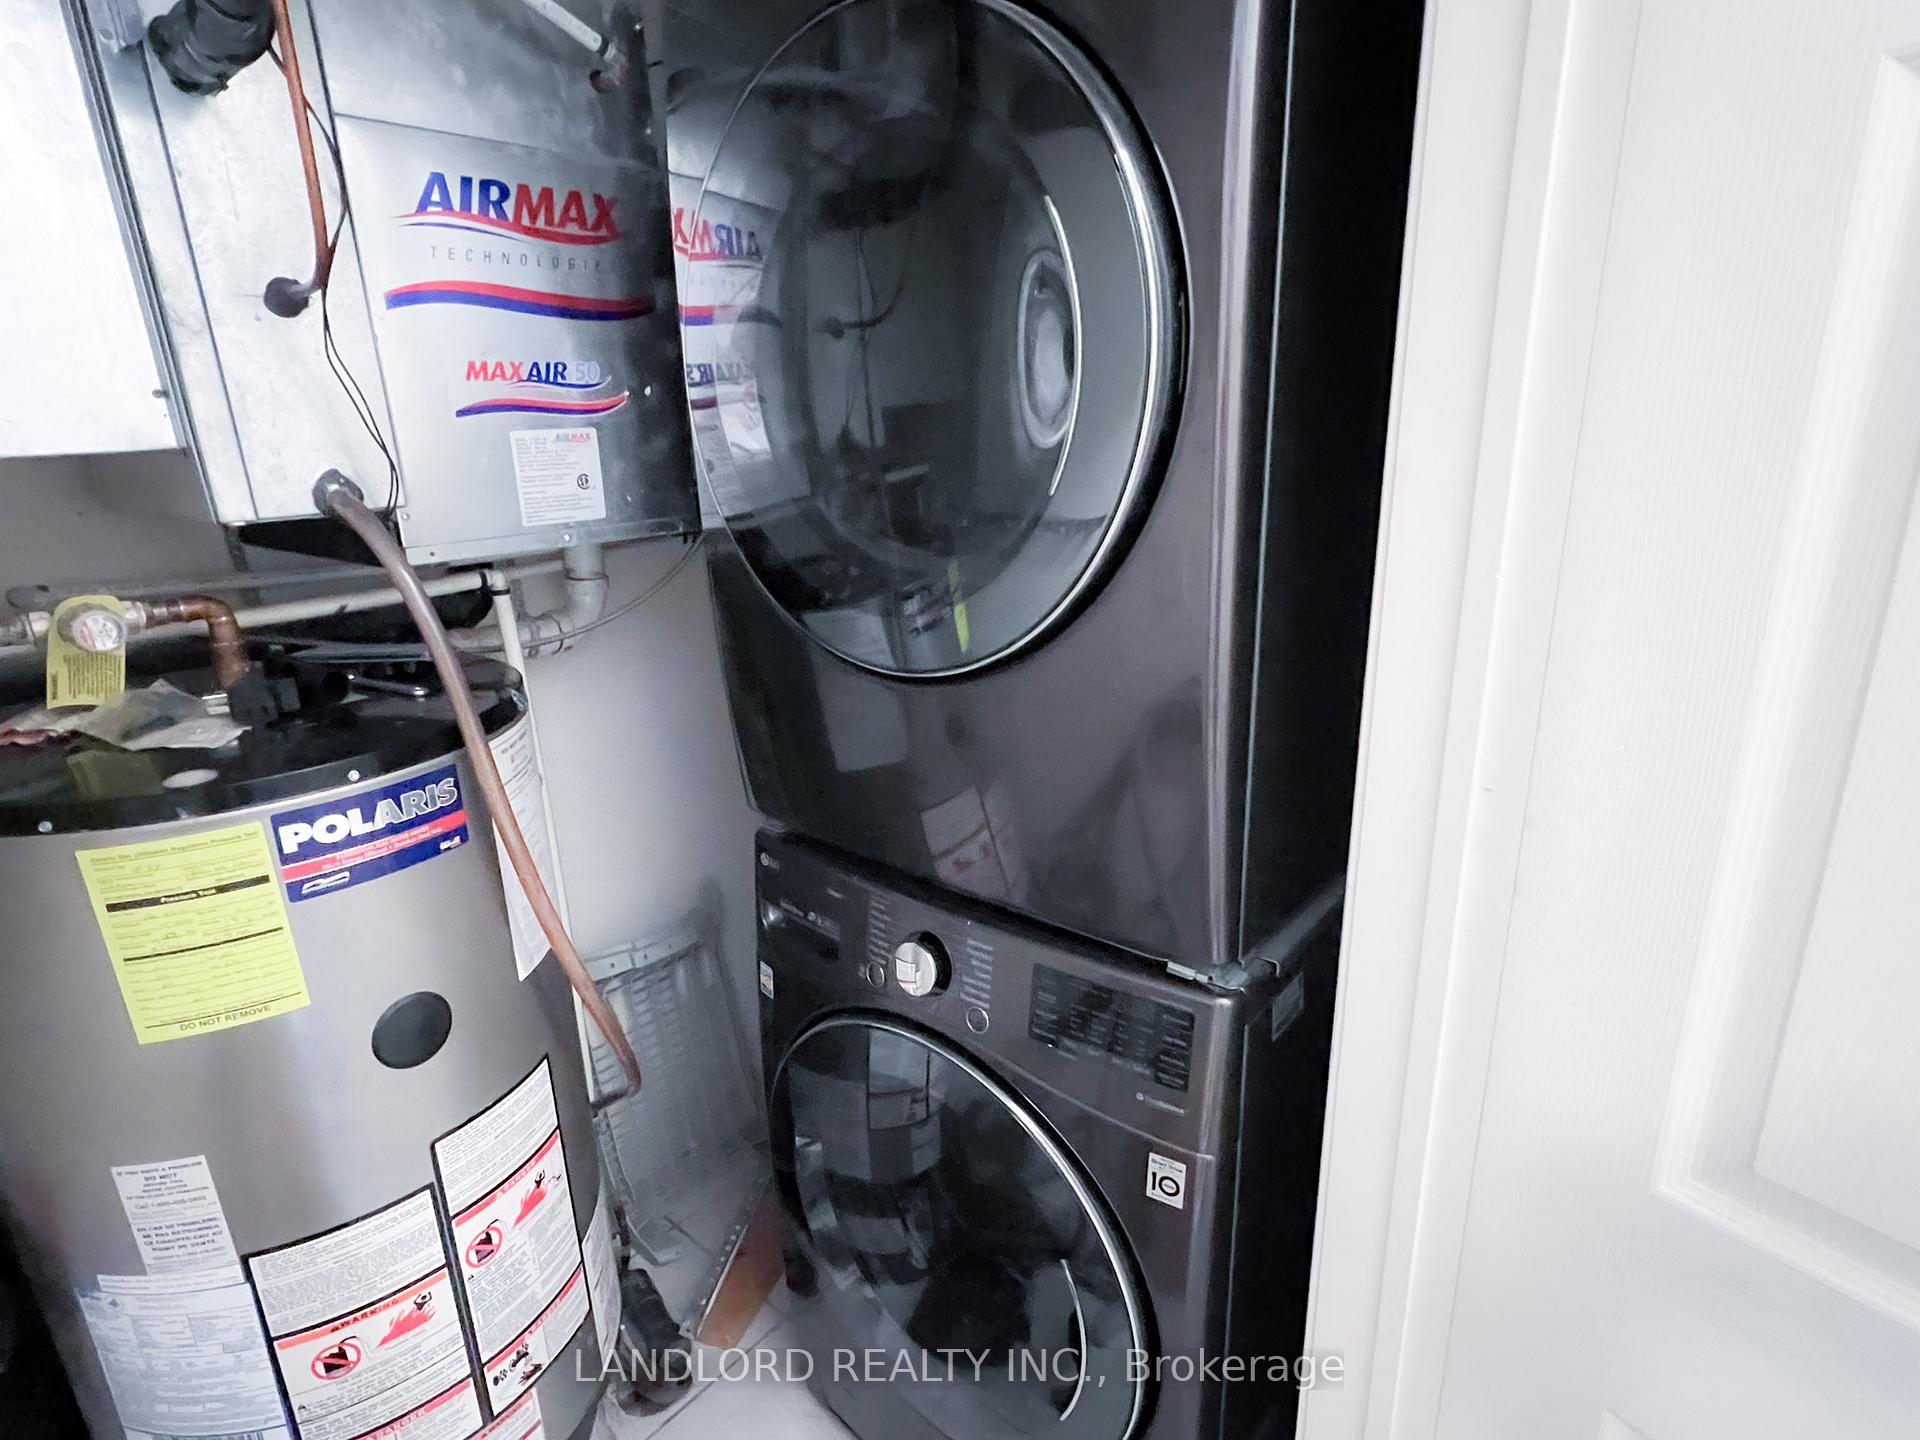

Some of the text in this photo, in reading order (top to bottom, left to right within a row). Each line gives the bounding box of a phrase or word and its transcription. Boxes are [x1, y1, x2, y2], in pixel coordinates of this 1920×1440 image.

[415, 171, 619, 235] AIRMAX
[465, 360, 568, 384] MAXAIR
[278, 777, 458, 855] POLARIS
[180, 1004, 271, 1031] DO NOT REMOVE
[1152, 1171, 1180, 1197] 10
[340, 1298, 399, 1328] WARNING
